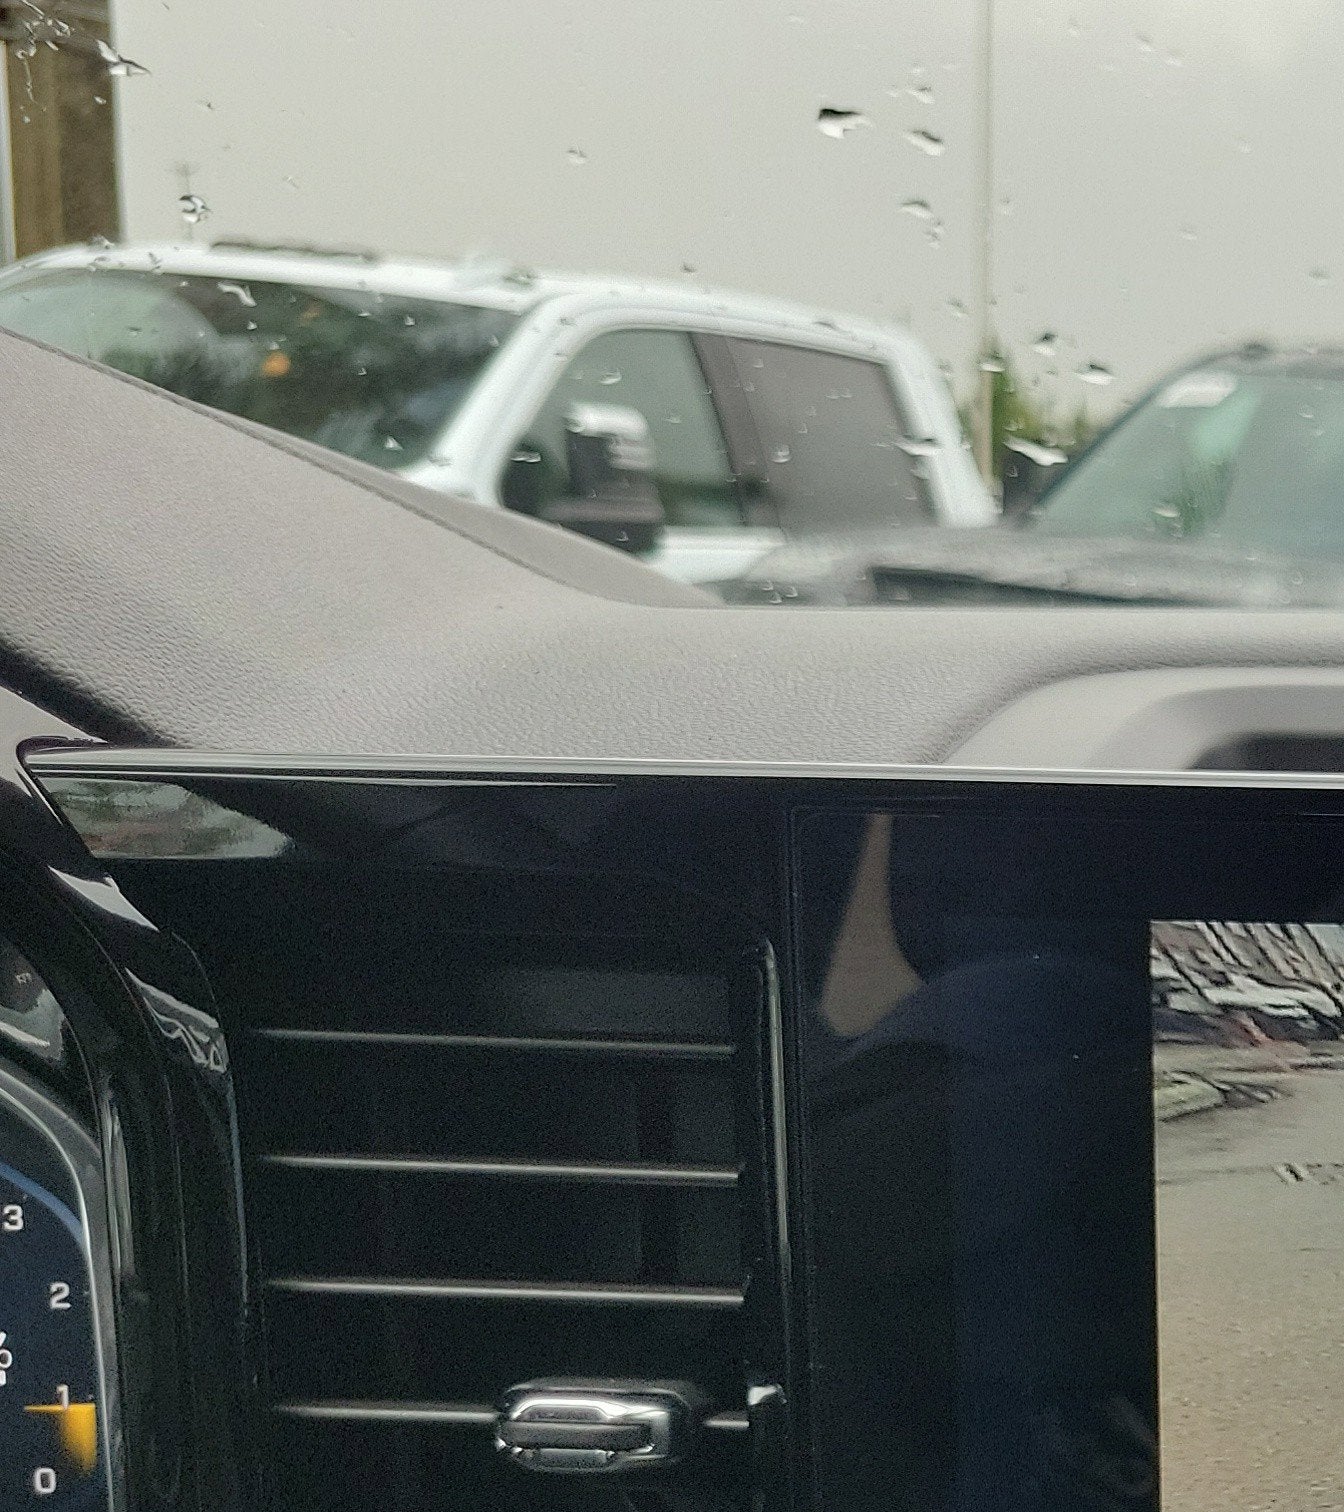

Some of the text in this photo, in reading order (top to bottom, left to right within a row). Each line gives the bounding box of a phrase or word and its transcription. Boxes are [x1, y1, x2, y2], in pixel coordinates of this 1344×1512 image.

[3, 1204, 24, 1231] 3
[49, 1281, 72, 1310] 2
[55, 1384, 69, 1411] 1
[34, 1467, 57, 1495] 0
